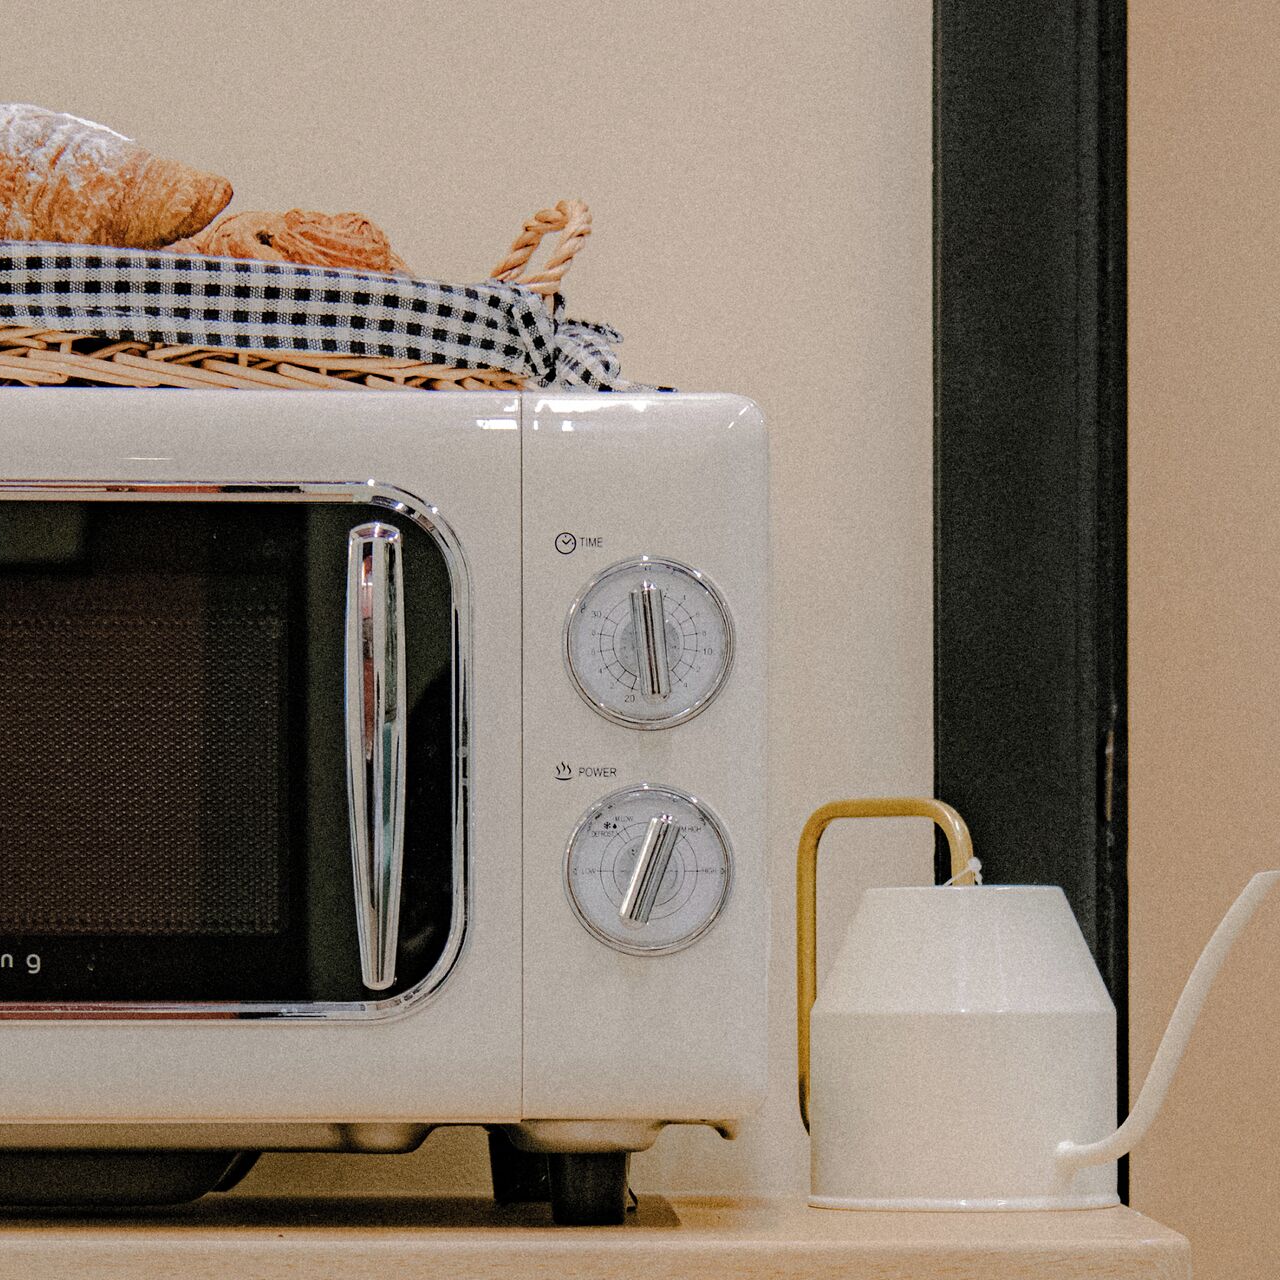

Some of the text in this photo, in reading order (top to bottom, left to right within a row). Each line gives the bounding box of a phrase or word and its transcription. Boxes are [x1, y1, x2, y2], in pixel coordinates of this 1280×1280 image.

[580, 537, 603, 548] TIME
[703, 647, 713, 656] 10
[624, 694, 636, 703] 20
[578, 768, 617, 778] POWER
